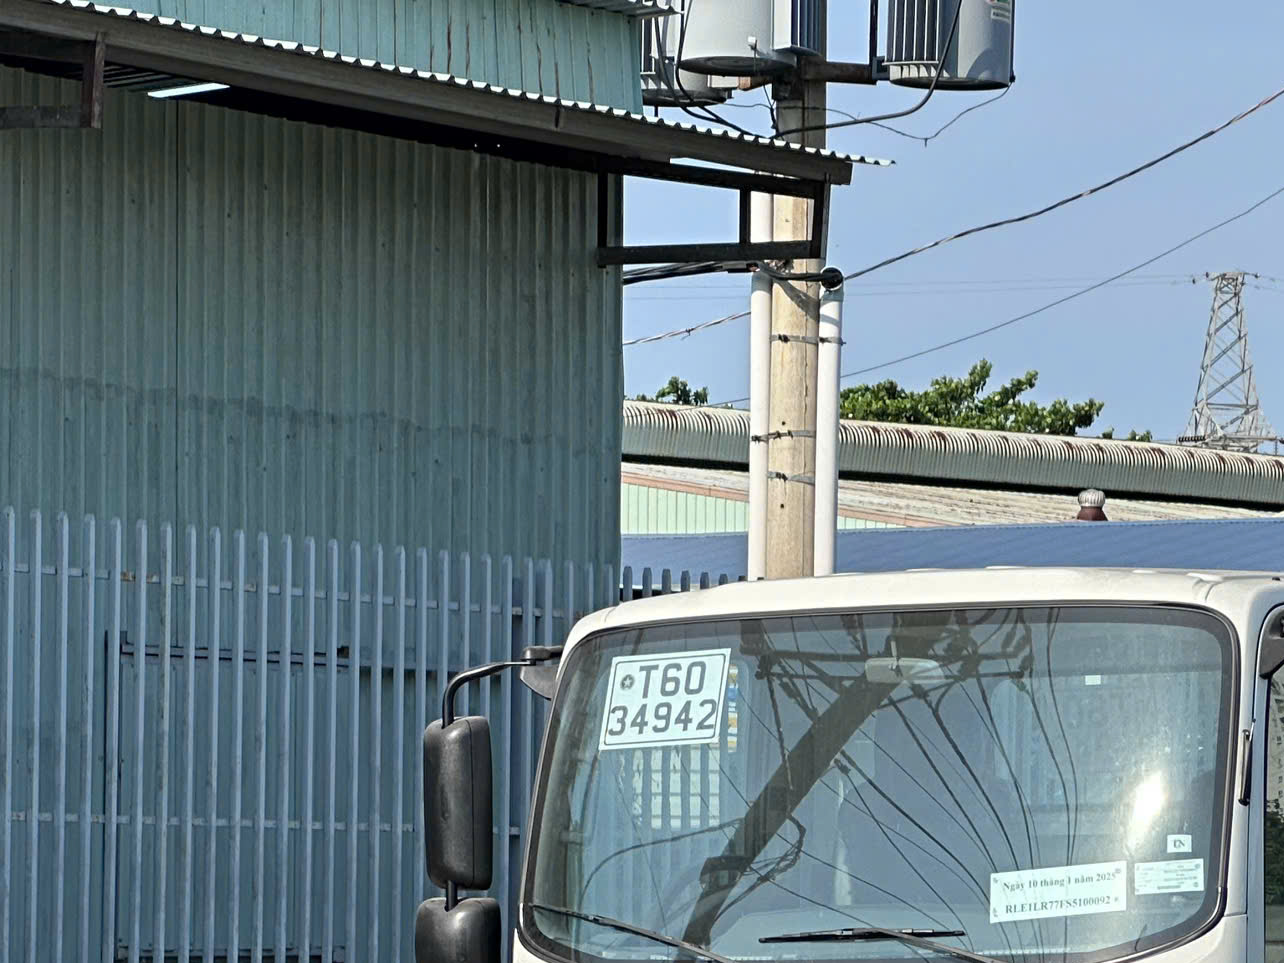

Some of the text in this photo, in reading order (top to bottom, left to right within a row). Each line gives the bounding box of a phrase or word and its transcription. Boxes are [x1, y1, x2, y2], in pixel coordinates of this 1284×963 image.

[638, 660, 707, 699] T60
[607, 698, 717, 737] 34942
[1003, 880, 1025, 892] Ngày
[1028, 879, 1038, 888] 10
[1040, 876, 1065, 888] tháng
[1074, 874, 1094, 884] năm
[1096, 872, 1116, 882] 2025
